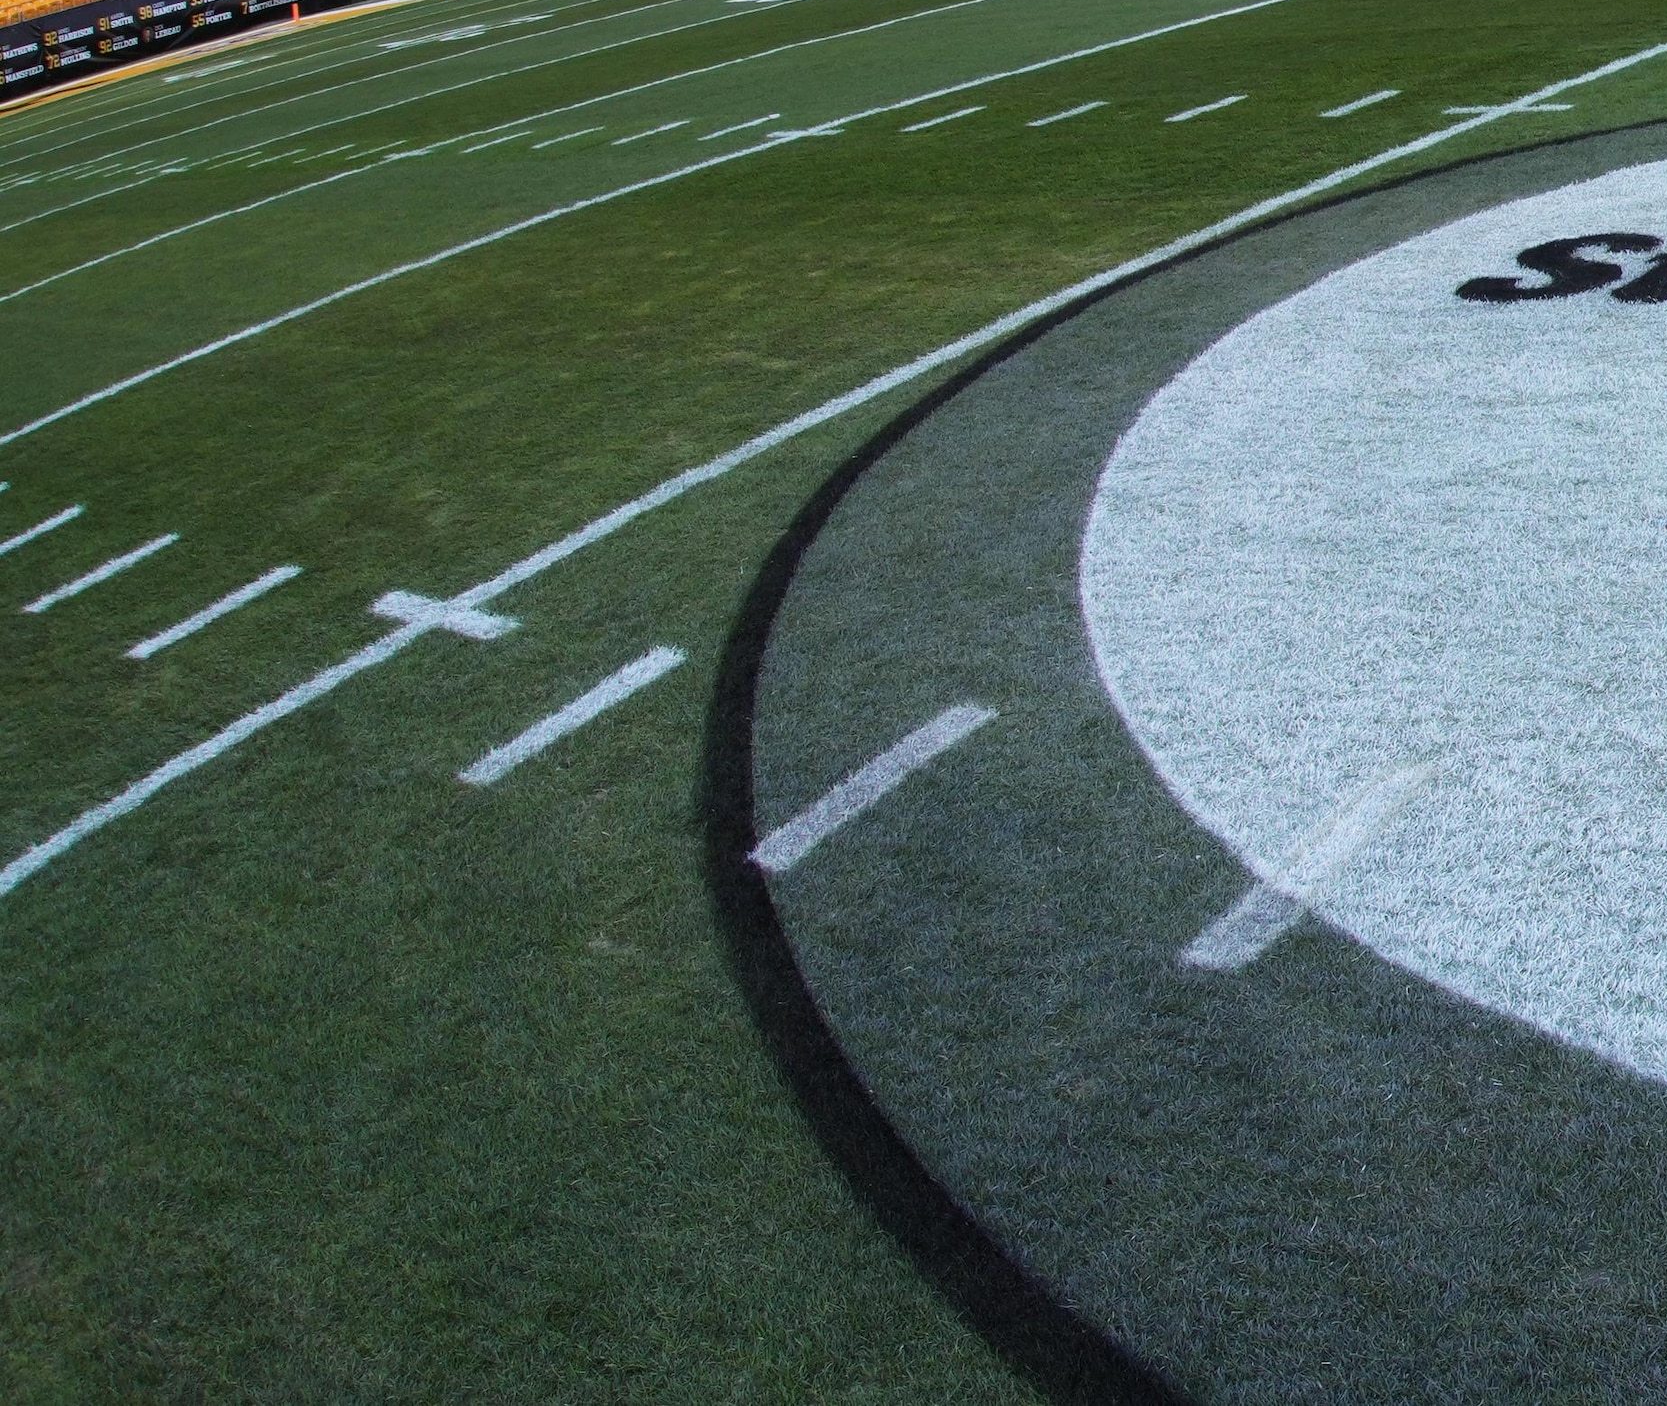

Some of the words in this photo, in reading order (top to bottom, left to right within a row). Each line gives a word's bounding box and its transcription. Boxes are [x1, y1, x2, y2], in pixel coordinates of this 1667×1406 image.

[139, 5, 153, 20] 98
[153, 2, 187, 17] HAMPTON
[241, 2, 248, 15] 7
[99, 17, 111, 32] 91
[110, 15, 134, 29] SMITH
[192, 13, 205, 28] 55
[205, 11, 233, 25] PORTER
[44, 31, 58, 47] 92
[58, 26, 95, 43] HARRISON
[155, 25, 182, 39] LEBEAU
[3, 43, 38, 60] MATHEWS
[99, 39, 113, 54] 92
[112, 37, 139, 51] GILDON
[45, 54, 61, 70] 72
[60, 50, 92, 66] MULLINS
[5, 65, 45, 84] MANSFIELD
